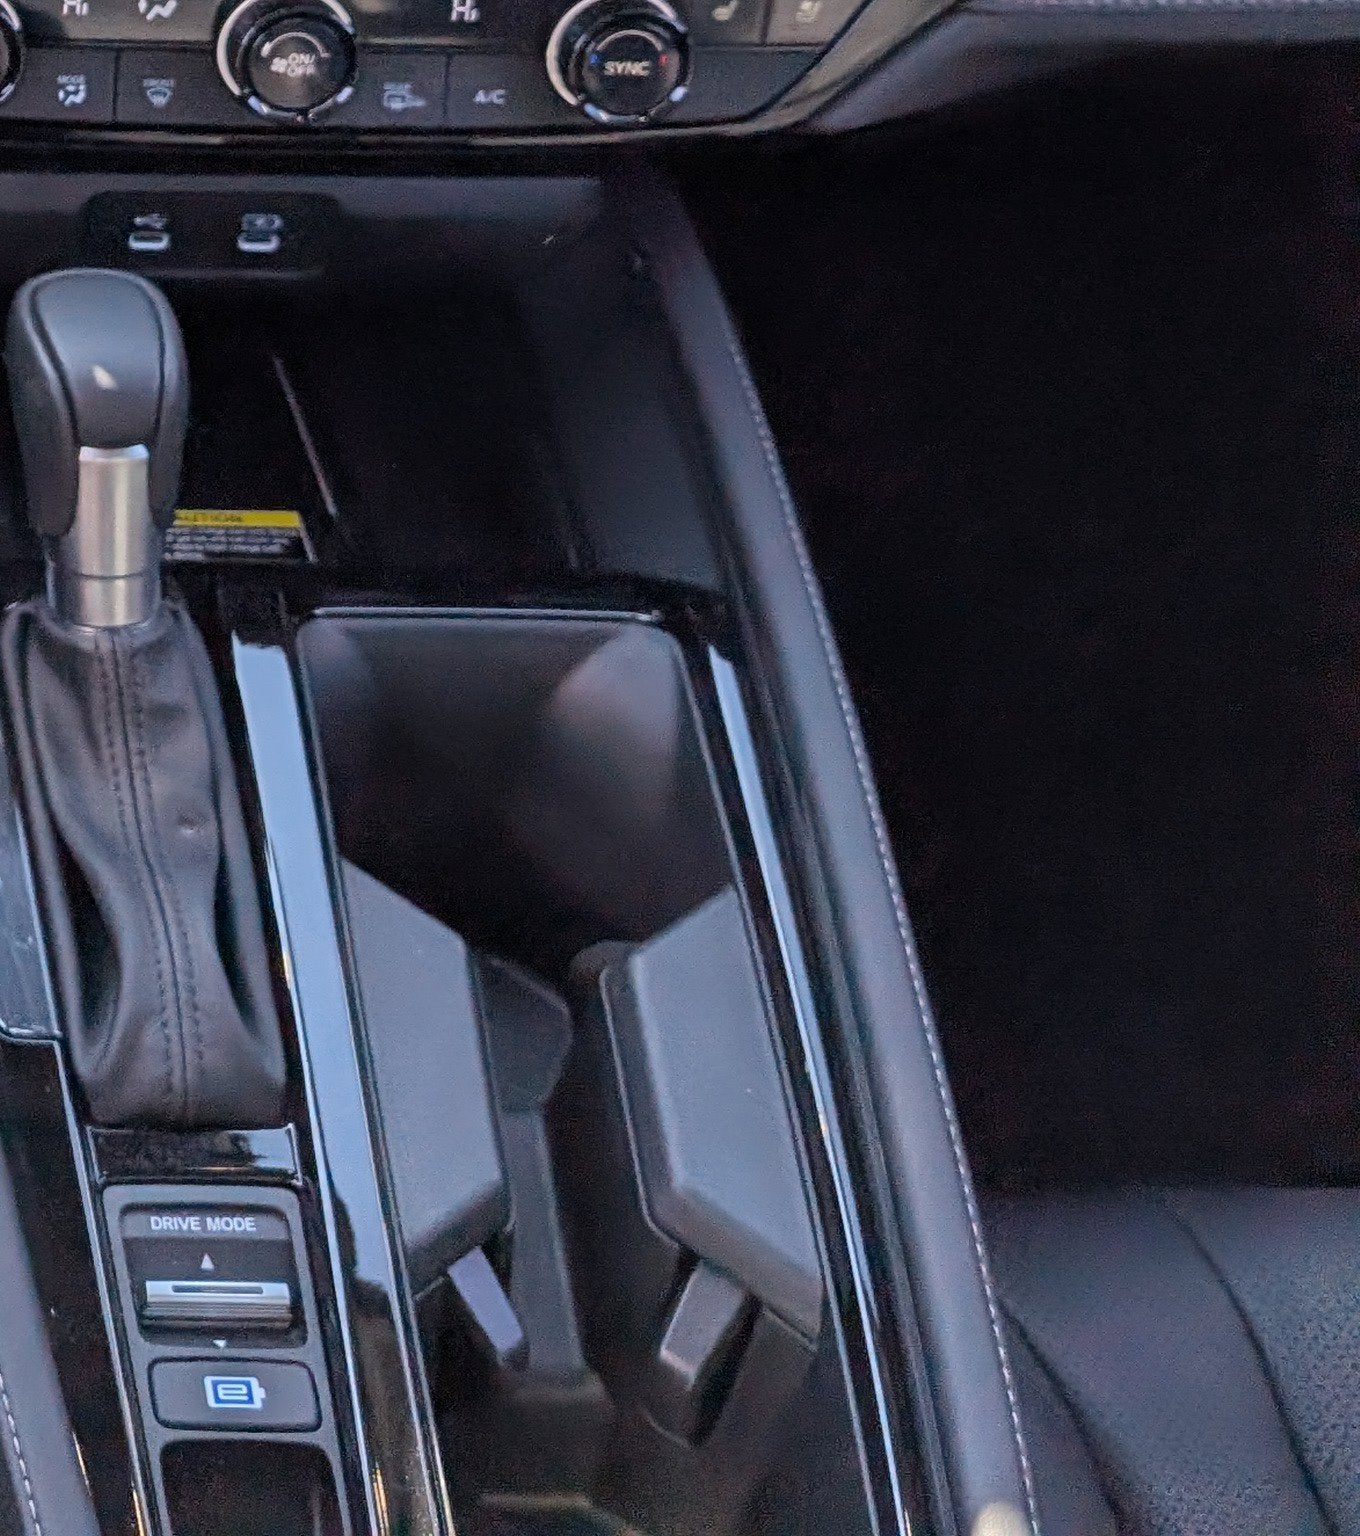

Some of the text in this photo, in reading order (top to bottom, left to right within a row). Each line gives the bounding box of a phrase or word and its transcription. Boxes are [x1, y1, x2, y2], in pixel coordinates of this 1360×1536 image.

[286, 64, 315, 77] OFF
[604, 61, 650, 77] SYNC
[149, 1215, 258, 1233] DRIVE MODE
